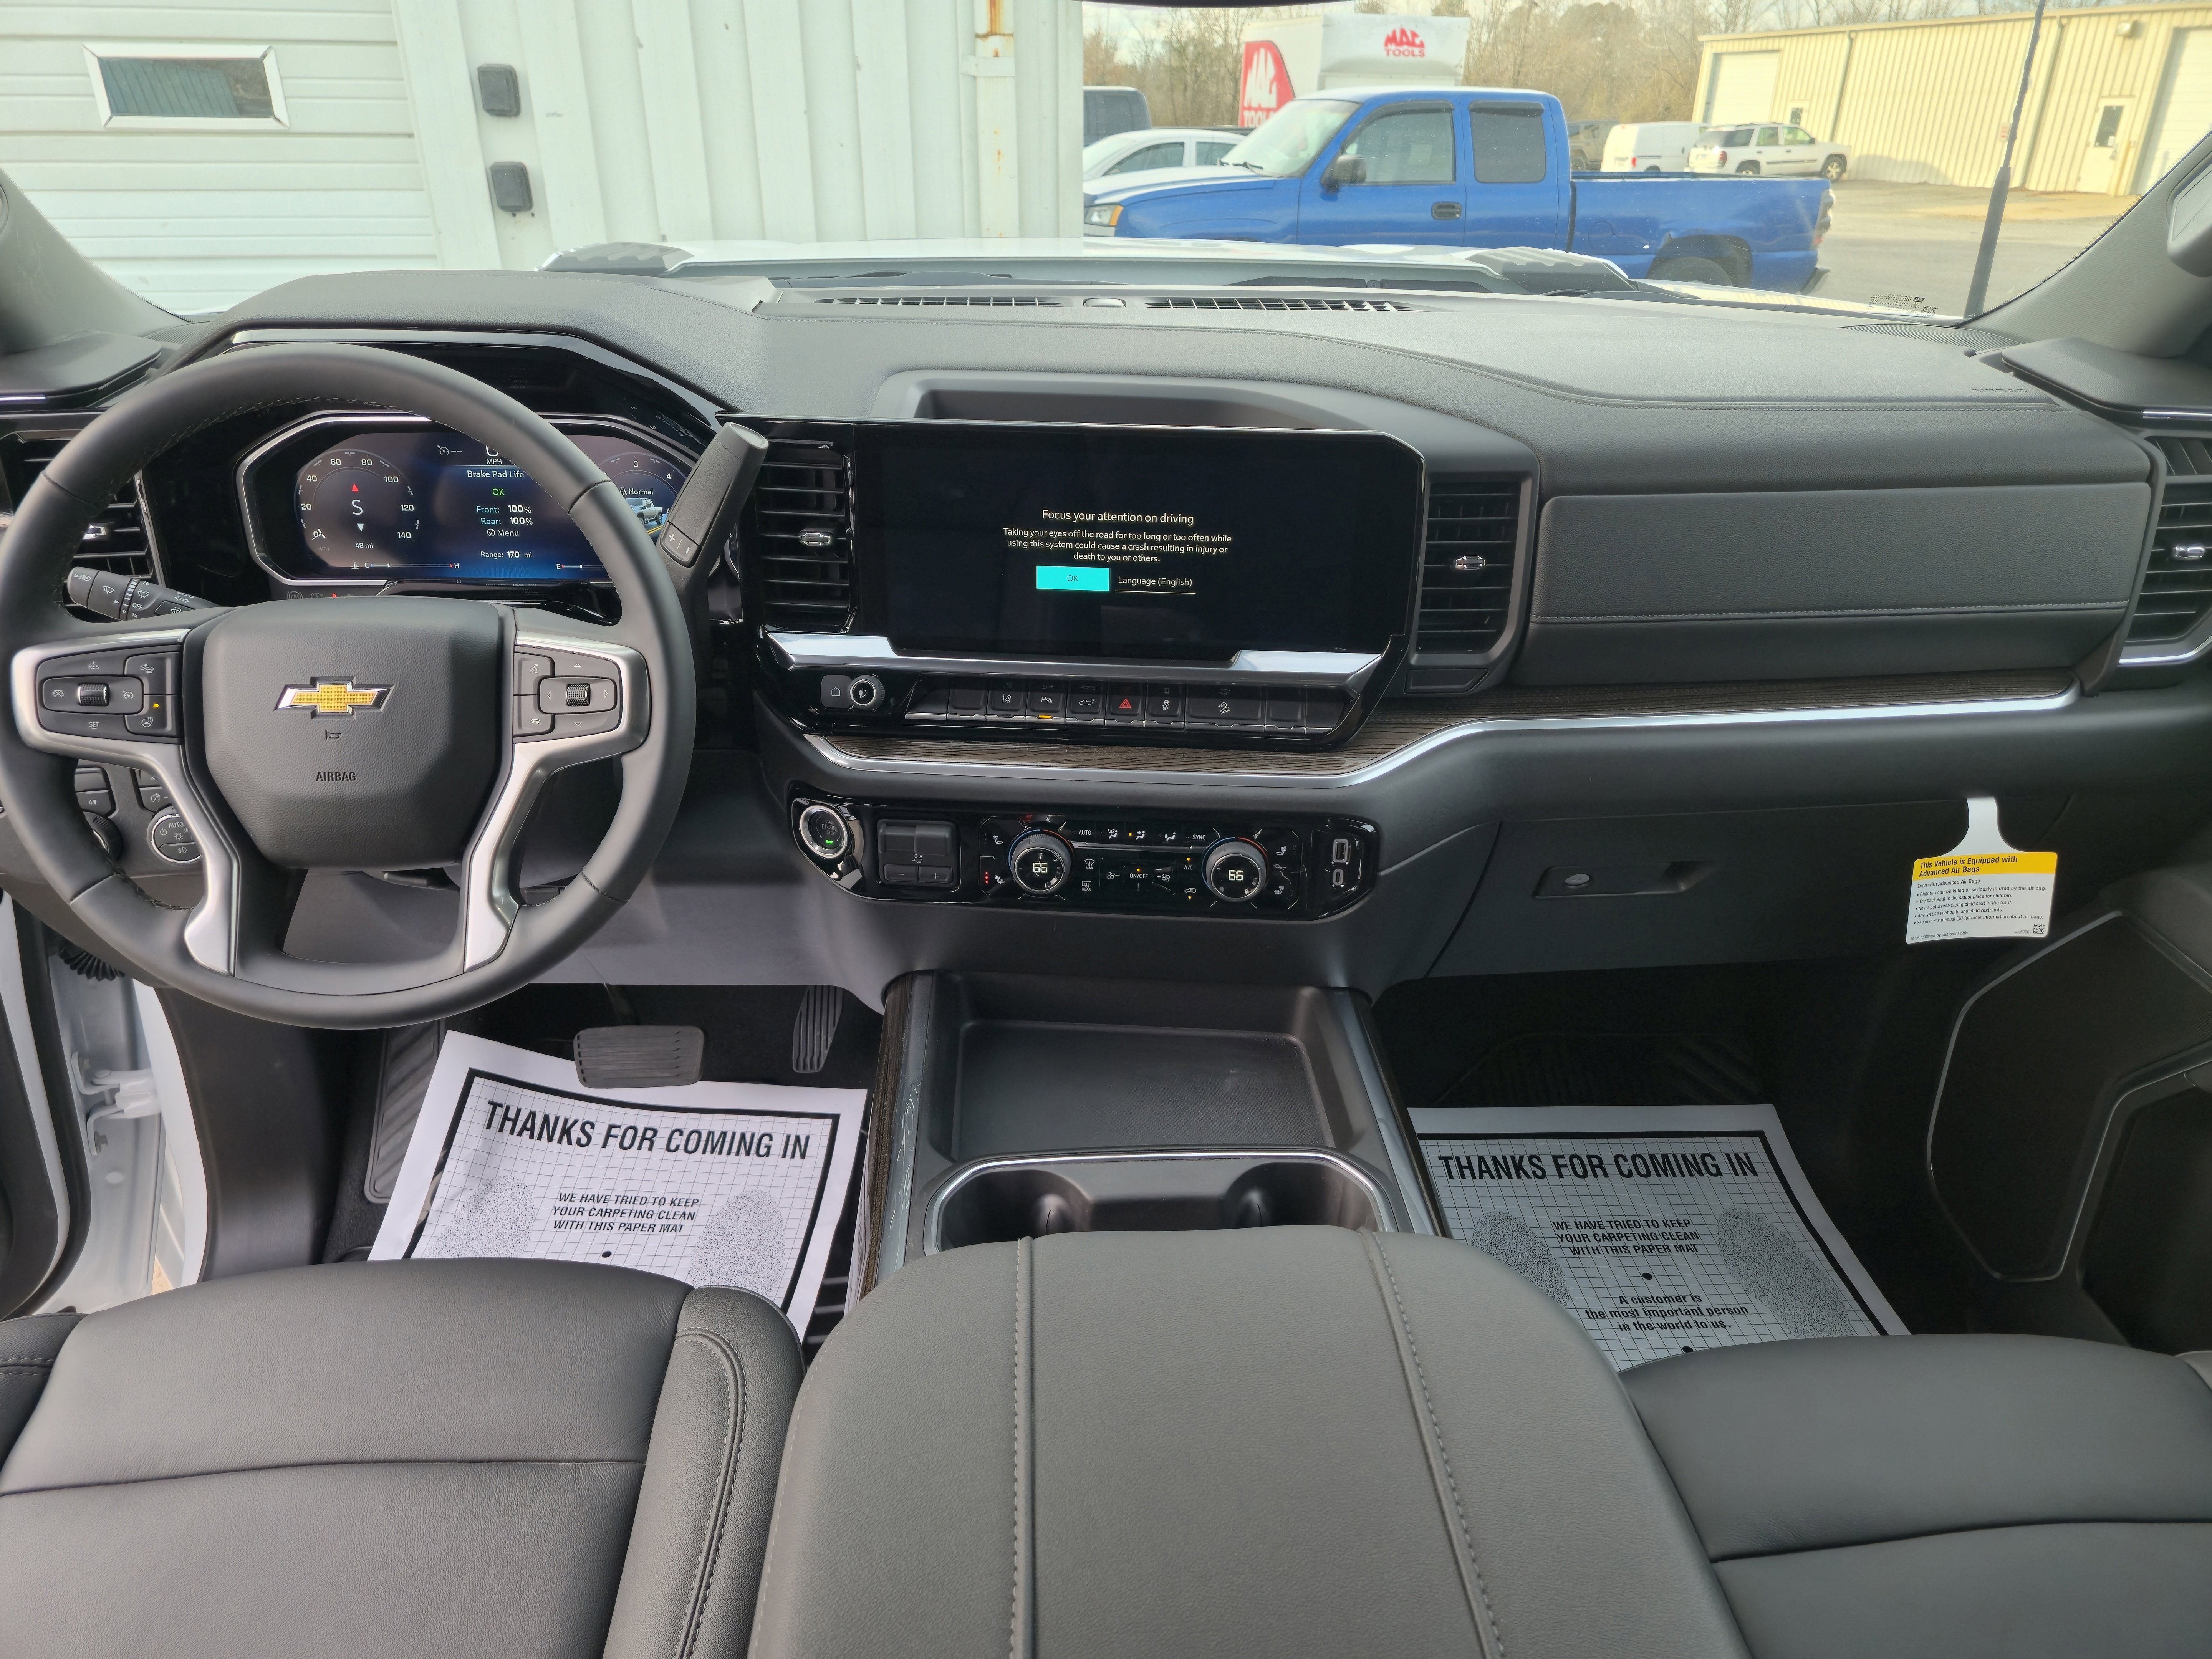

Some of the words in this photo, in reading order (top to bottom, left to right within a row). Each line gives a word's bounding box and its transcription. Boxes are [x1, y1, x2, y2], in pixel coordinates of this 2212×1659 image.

[1384, 27, 1426, 49] MAC
[1384, 48, 1426, 57] TOOLS
[1244, 47, 1277, 108] MAC
[352, 499, 363, 515] S
[508, 505, 531, 513] 100%
[1043, 510, 1071, 519] Focus
[1073, 513, 1095, 522] your
[1098, 512, 1142, 522] attention
[1160, 513, 1194, 526] driving
[1003, 528, 1028, 537] Taking
[1144, 532, 1161, 542] long
[1008, 540, 1028, 548] using
[1046, 541, 1073, 549] system
[1151, 544, 1184, 553] resulting
[1196, 545, 1217, 555] injury
[1118, 576, 1156, 586] Language
[1158, 578, 1192, 587] (English)
[316, 771, 356, 782] AIRBAG
[1967, 856, 2000, 865] Equipped
[1033, 863, 1047, 873] 66
[1919, 868, 1949, 877] Advanced
[1229, 870, 1243, 881] 66
[485, 1100, 595, 1147] THANKS
[601, 1124, 658, 1151] FOR
[666, 1129, 774, 1158] COMING
[781, 1134, 810, 1159] IN
[1438, 1154, 1547, 1180] THANKS
[1553, 1154, 1609, 1179] FOR
[1614, 1152, 1723, 1178] COMING
[1726, 1152, 1758, 1176] IN
[558, 1192, 578, 1202] WE
[580, 1193, 611, 1204] HAVE
[614, 1195, 647, 1205] TRIED
[652, 1196, 666, 1206] TO
[670, 1197, 699, 1207] KEEP
[553, 1206, 585, 1216] YOUR
[588, 1207, 654, 1219] CARPETING
[657, 1210, 696, 1220] CLEAN
[553, 1220, 584, 1230] WITH
[588, 1221, 615, 1231] THIS
[617, 1222, 656, 1232] PAPER
[659, 1224, 685, 1233] MAT
[1619, 1295, 1628, 1305] A
[1631, 1295, 1687, 1304] customer
[1690, 1294, 1702, 1303] is
[1585, 1309, 1606, 1318] the
[1609, 1309, 1639, 1318] most
[1643, 1306, 1703, 1318] important
[1707, 1306, 1749, 1316] person
[1617, 1322, 1631, 1331] in
[1633, 1321, 1654, 1331] the
[1656, 1320, 1691, 1330] world
[1694, 1320, 1707, 1329] to
[1710, 1320, 1731, 1328] us.
